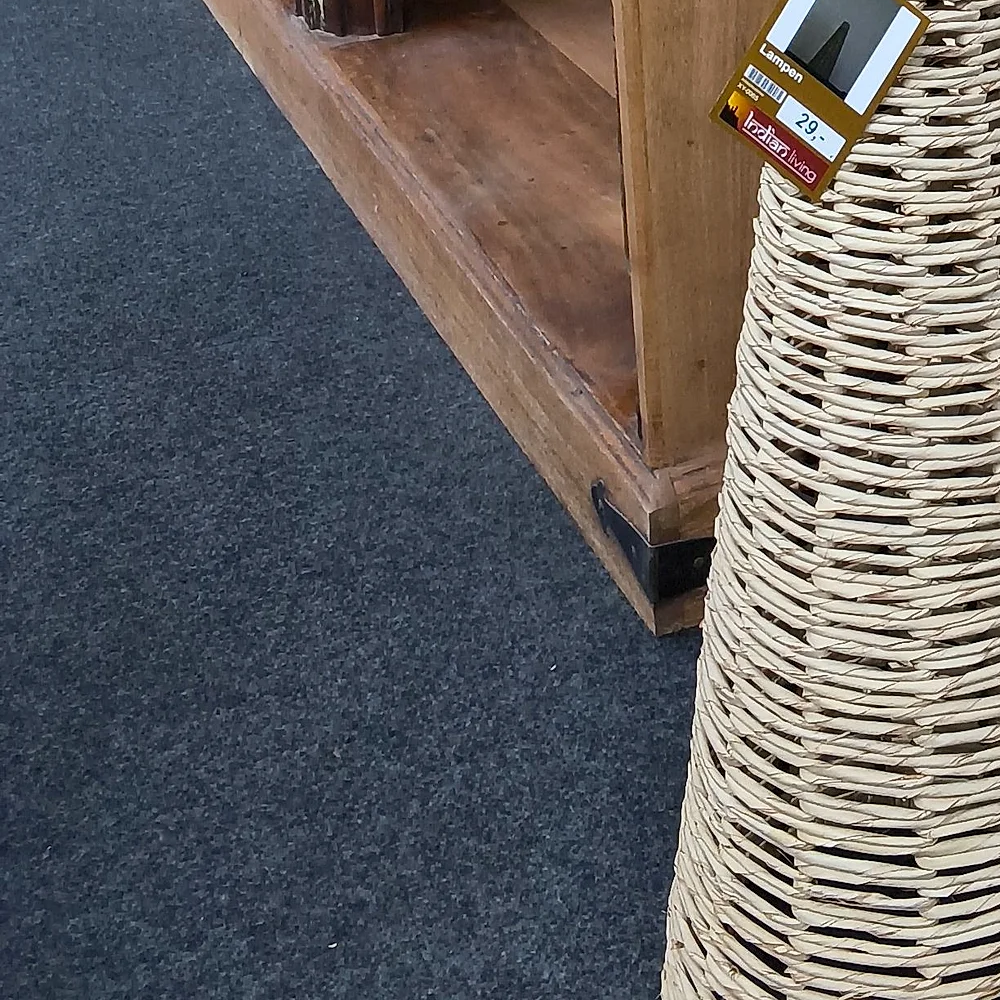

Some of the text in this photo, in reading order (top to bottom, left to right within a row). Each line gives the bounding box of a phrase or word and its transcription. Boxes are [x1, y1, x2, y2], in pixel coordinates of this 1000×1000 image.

[759, 43, 804, 83] Lampen
[743, 111, 817, 184] Indian living
